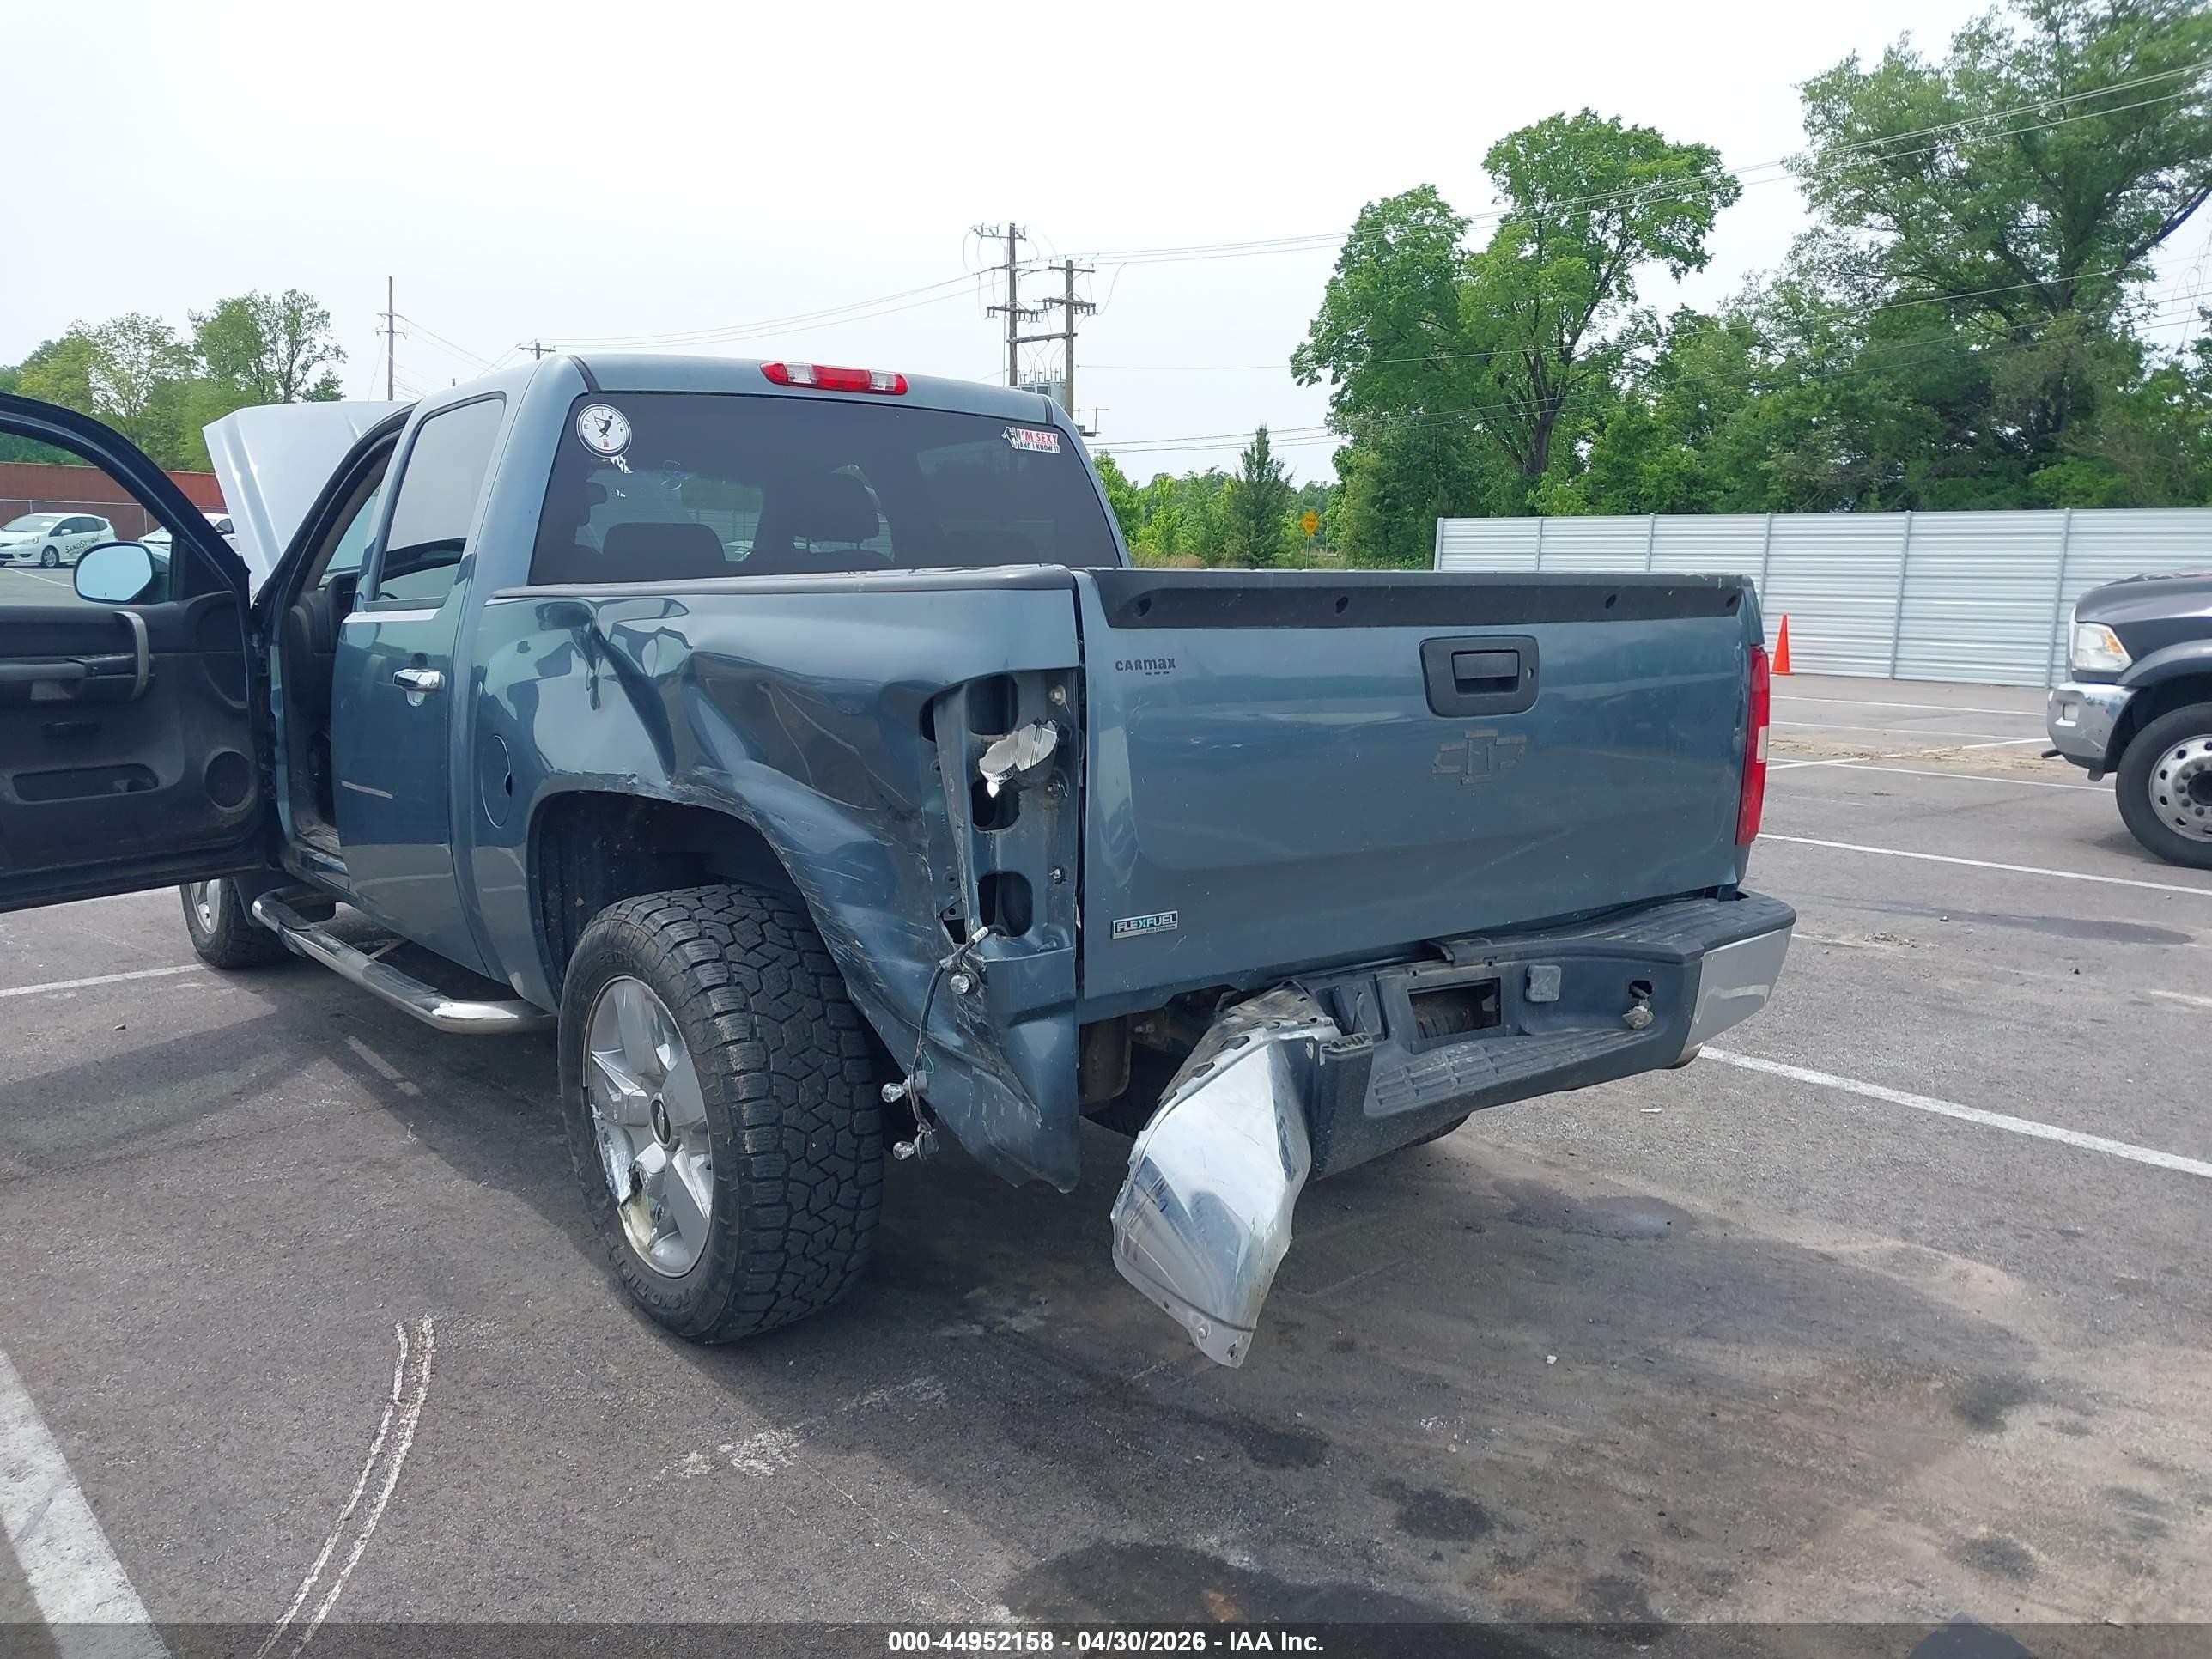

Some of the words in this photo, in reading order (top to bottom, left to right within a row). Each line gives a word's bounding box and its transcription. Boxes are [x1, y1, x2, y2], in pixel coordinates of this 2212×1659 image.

[1018, 430, 1033, 441] I'M
[1036, 432, 1057, 445] SEXY
[1116, 915, 1176, 933] FLEXFUEL
